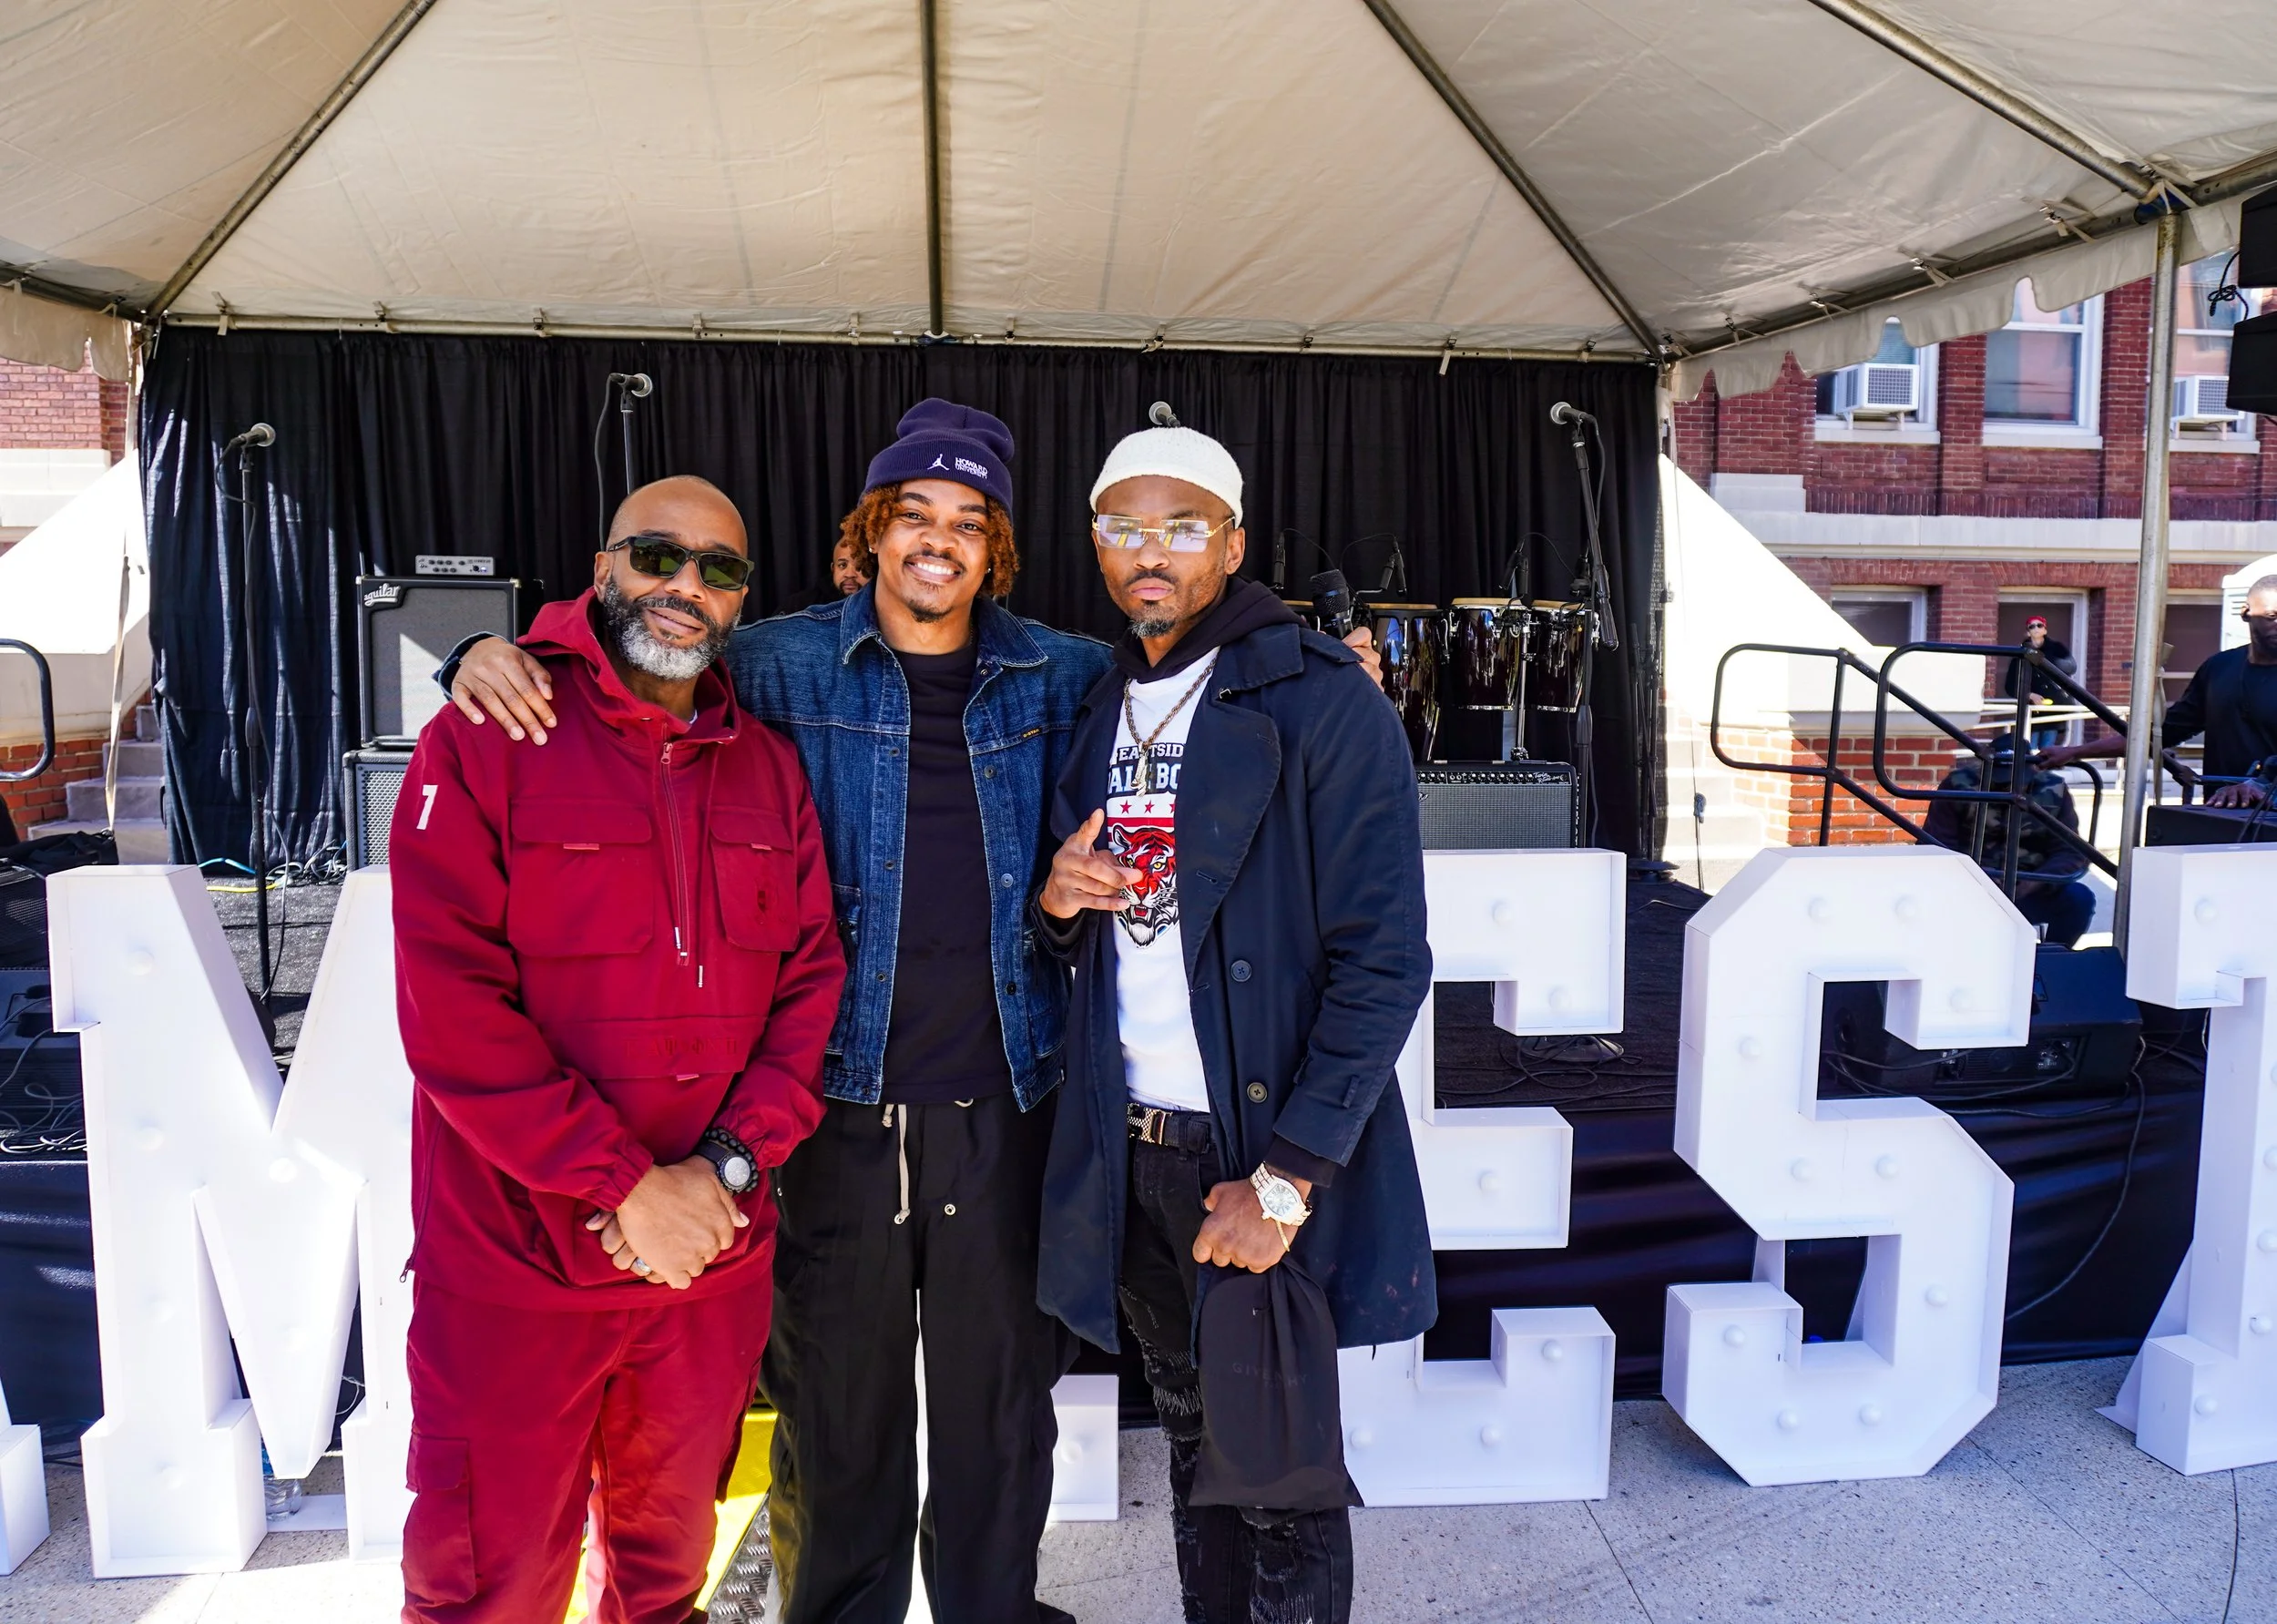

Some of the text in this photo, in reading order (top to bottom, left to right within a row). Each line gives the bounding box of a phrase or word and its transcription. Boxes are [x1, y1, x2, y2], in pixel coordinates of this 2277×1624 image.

[955, 456, 988, 475] HOWARD
[955, 464, 988, 480] UNIVERSITY
[363, 583, 401, 607] aguilar
[1118, 743, 1185, 761] EATSID
[416, 784, 438, 830] 7
